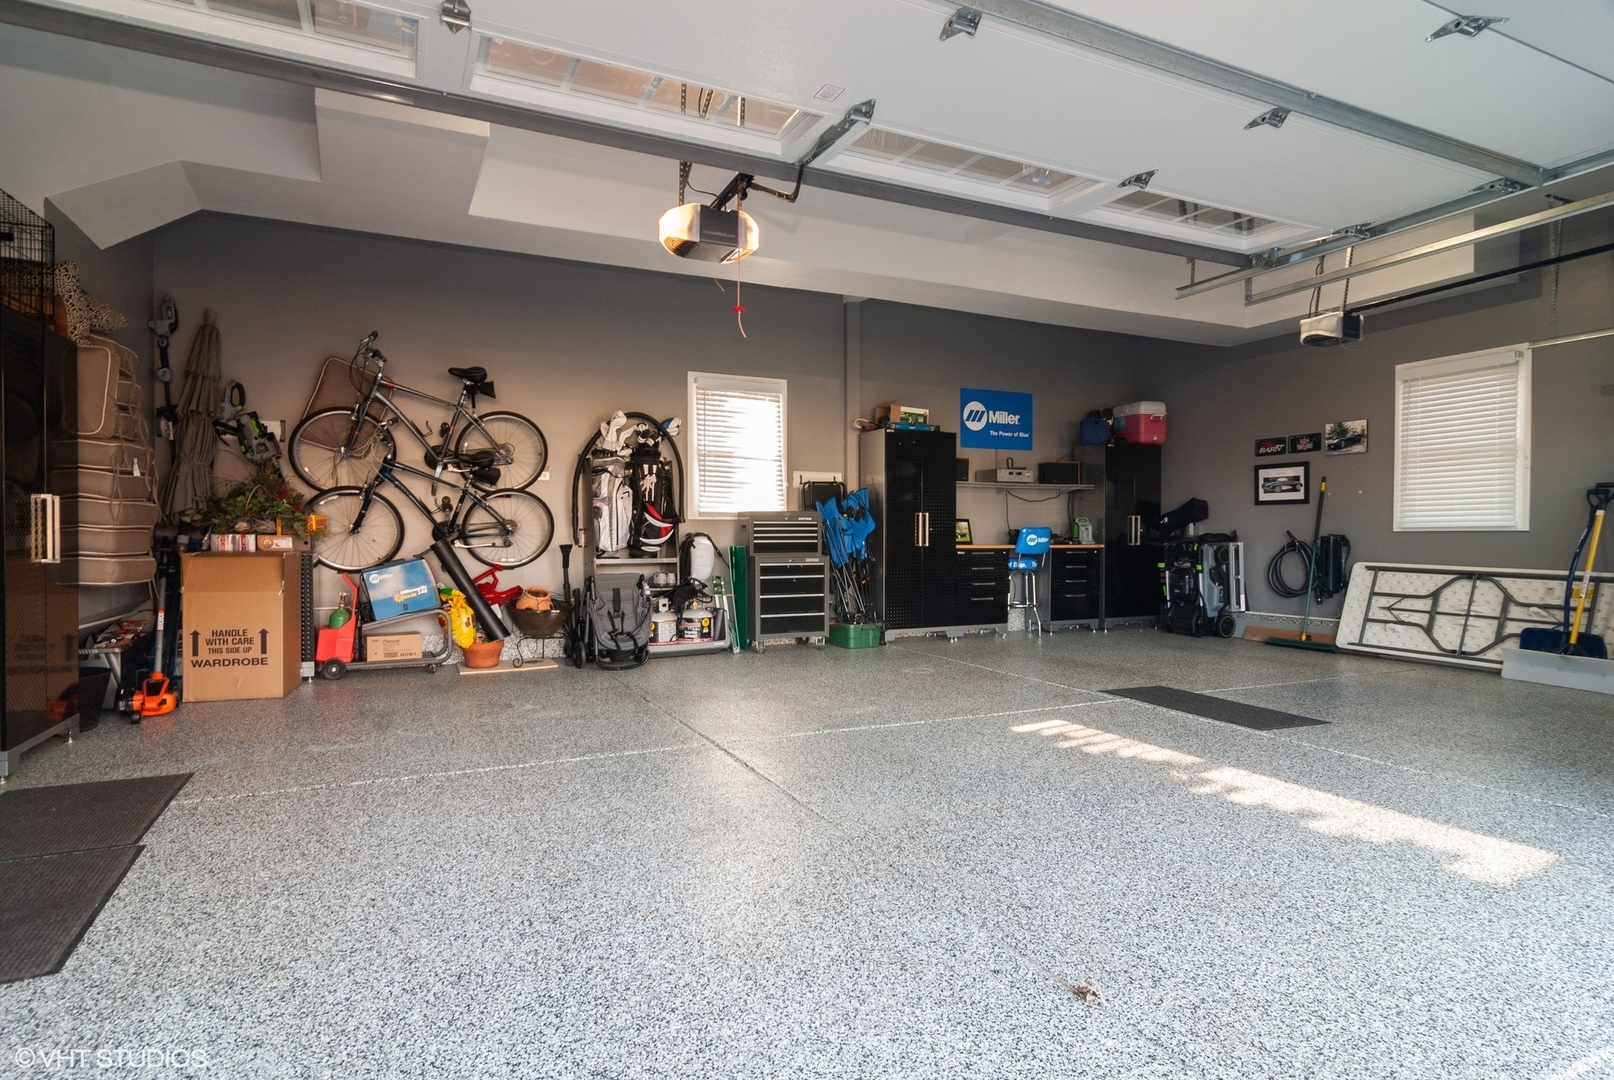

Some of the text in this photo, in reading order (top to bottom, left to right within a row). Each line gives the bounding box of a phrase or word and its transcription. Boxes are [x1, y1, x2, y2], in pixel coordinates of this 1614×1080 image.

[988, 410, 1020, 425] Miller
[211, 629, 248, 638] HANDLE
[205, 637, 255, 646] WITH CARE
[191, 657, 269, 668] WARDROBE
